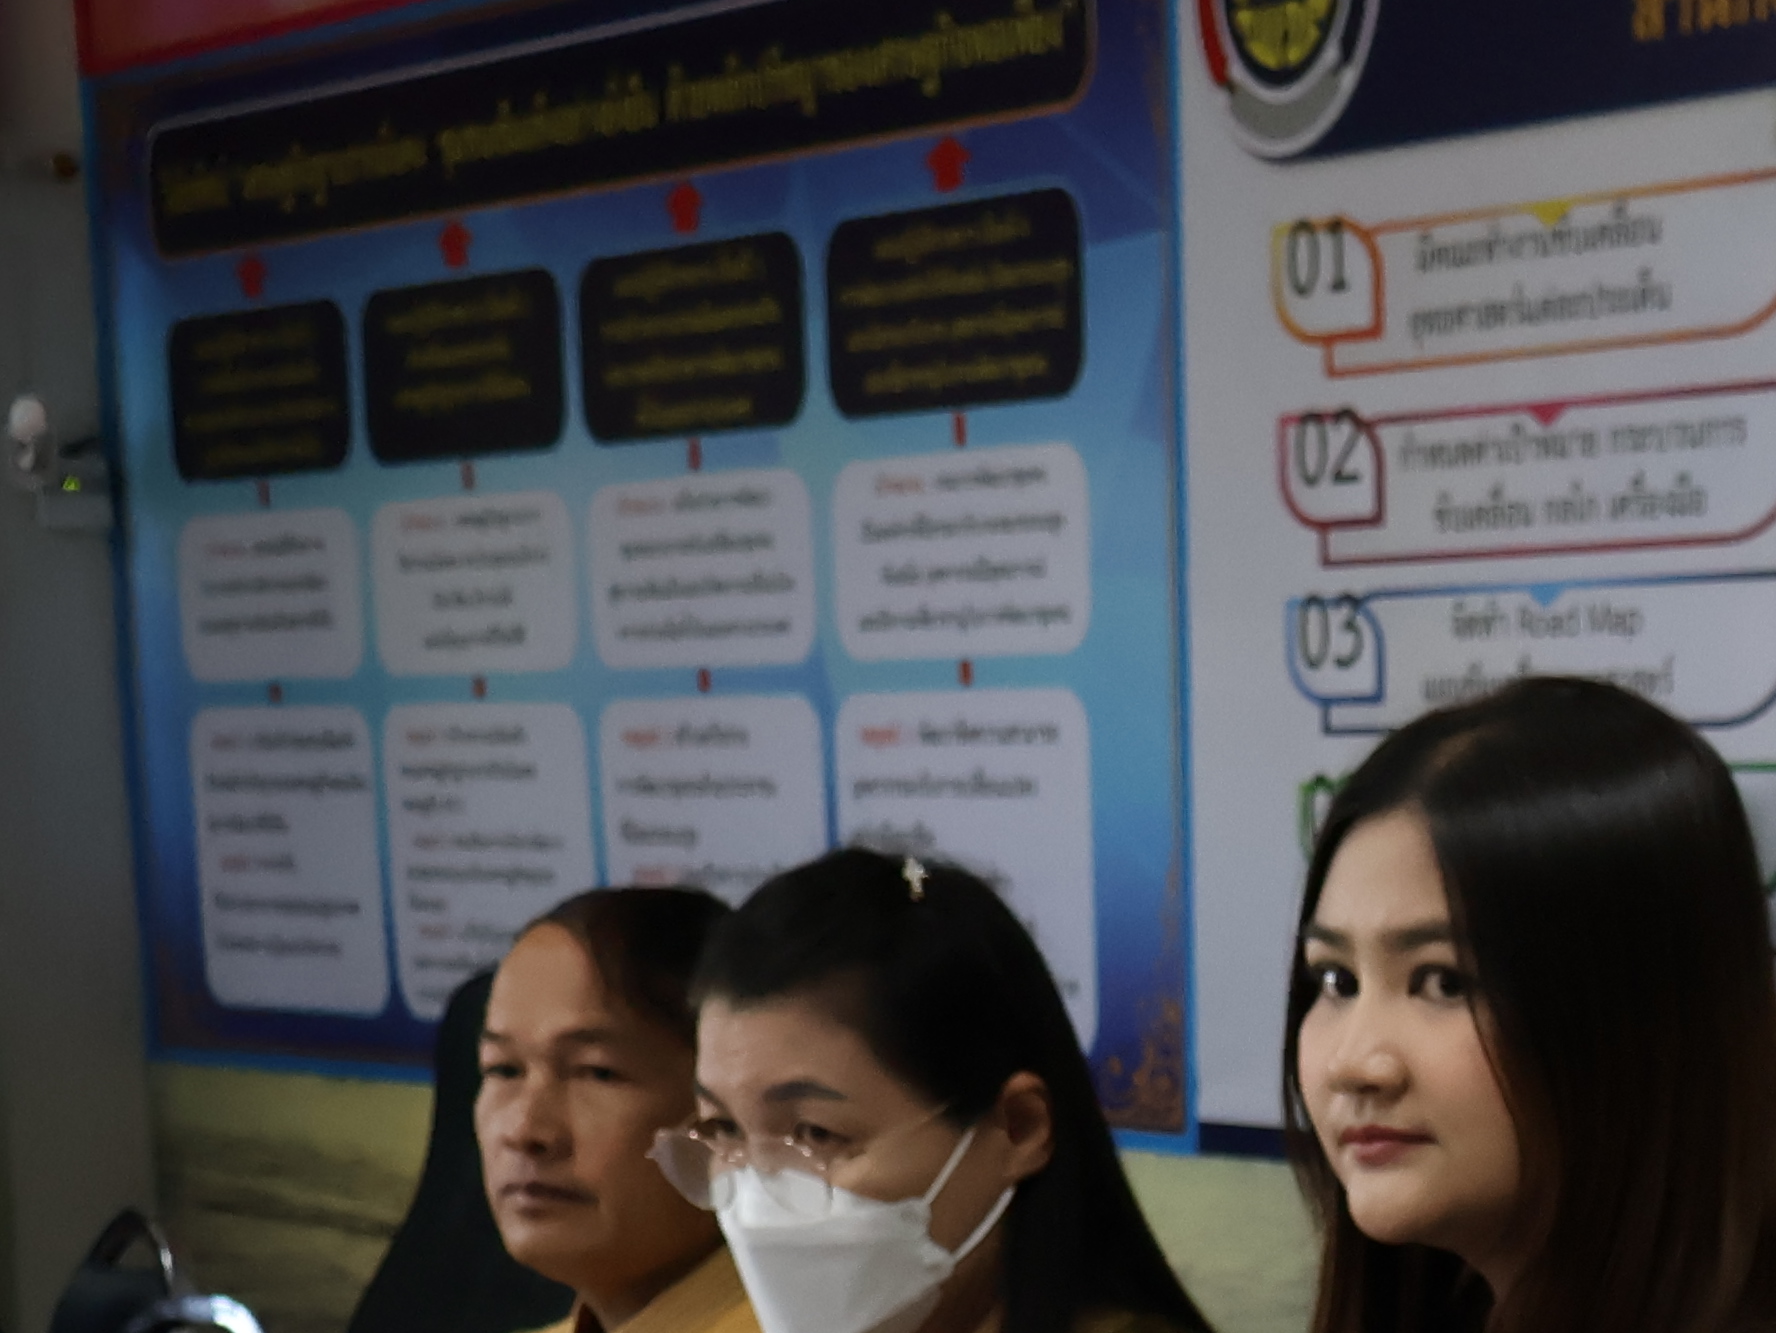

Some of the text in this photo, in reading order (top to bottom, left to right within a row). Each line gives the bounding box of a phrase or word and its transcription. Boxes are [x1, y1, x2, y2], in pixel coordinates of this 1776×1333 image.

[1286, 217, 1350, 298] 01
[1292, 408, 1361, 488] 02
[1297, 595, 1366, 669] 03
